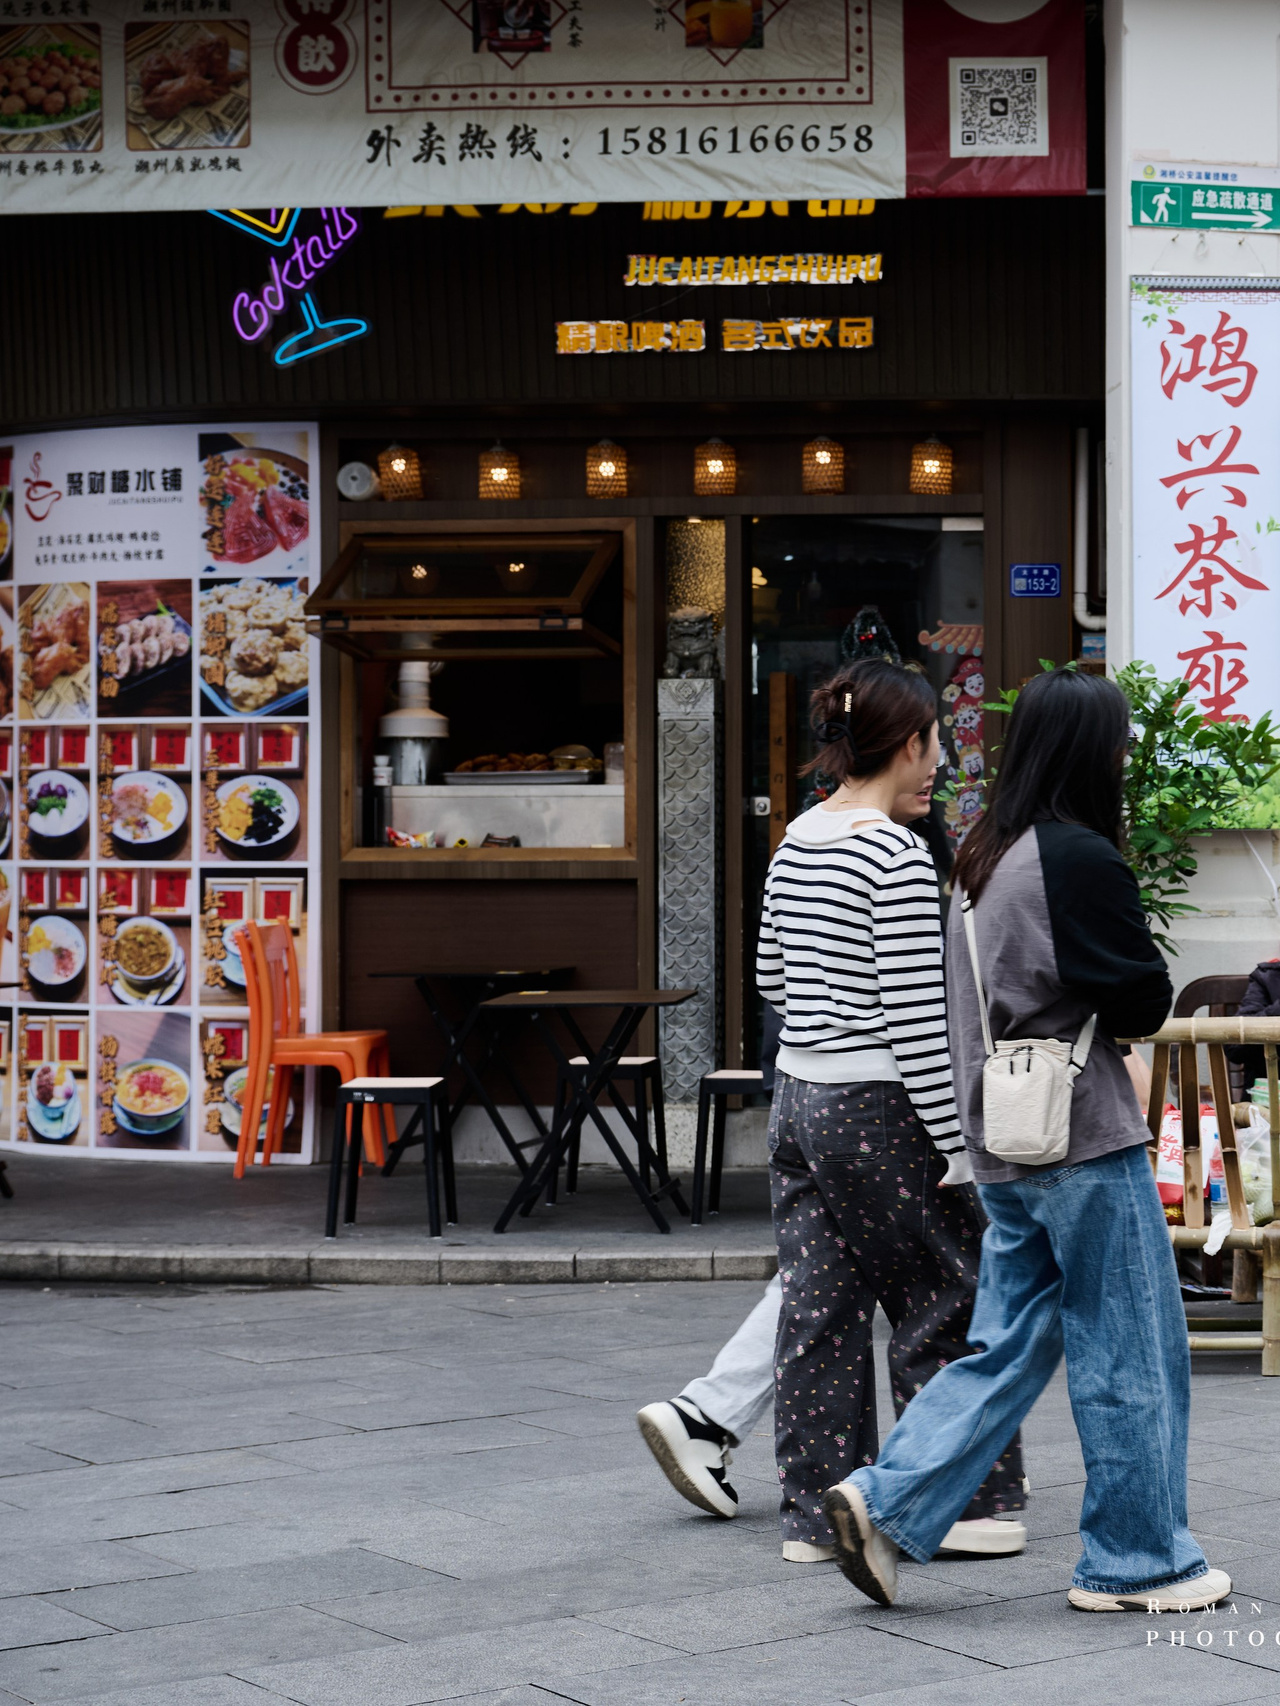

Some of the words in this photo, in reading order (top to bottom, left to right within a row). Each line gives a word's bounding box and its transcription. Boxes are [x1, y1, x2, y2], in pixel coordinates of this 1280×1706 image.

[597, 121, 875, 157] 15816166658
[1190, 189, 1275, 211] 应急疏散通道
[626, 255, 882, 284] JUCAITANGSHUIPU
[556, 319, 705, 353] 精酿啤酒
[720, 317, 875, 352] 各式饮品
[66, 468, 183, 497] 聚财糖水铺
[1154, 310, 1270, 728] 鸿兴茶座
